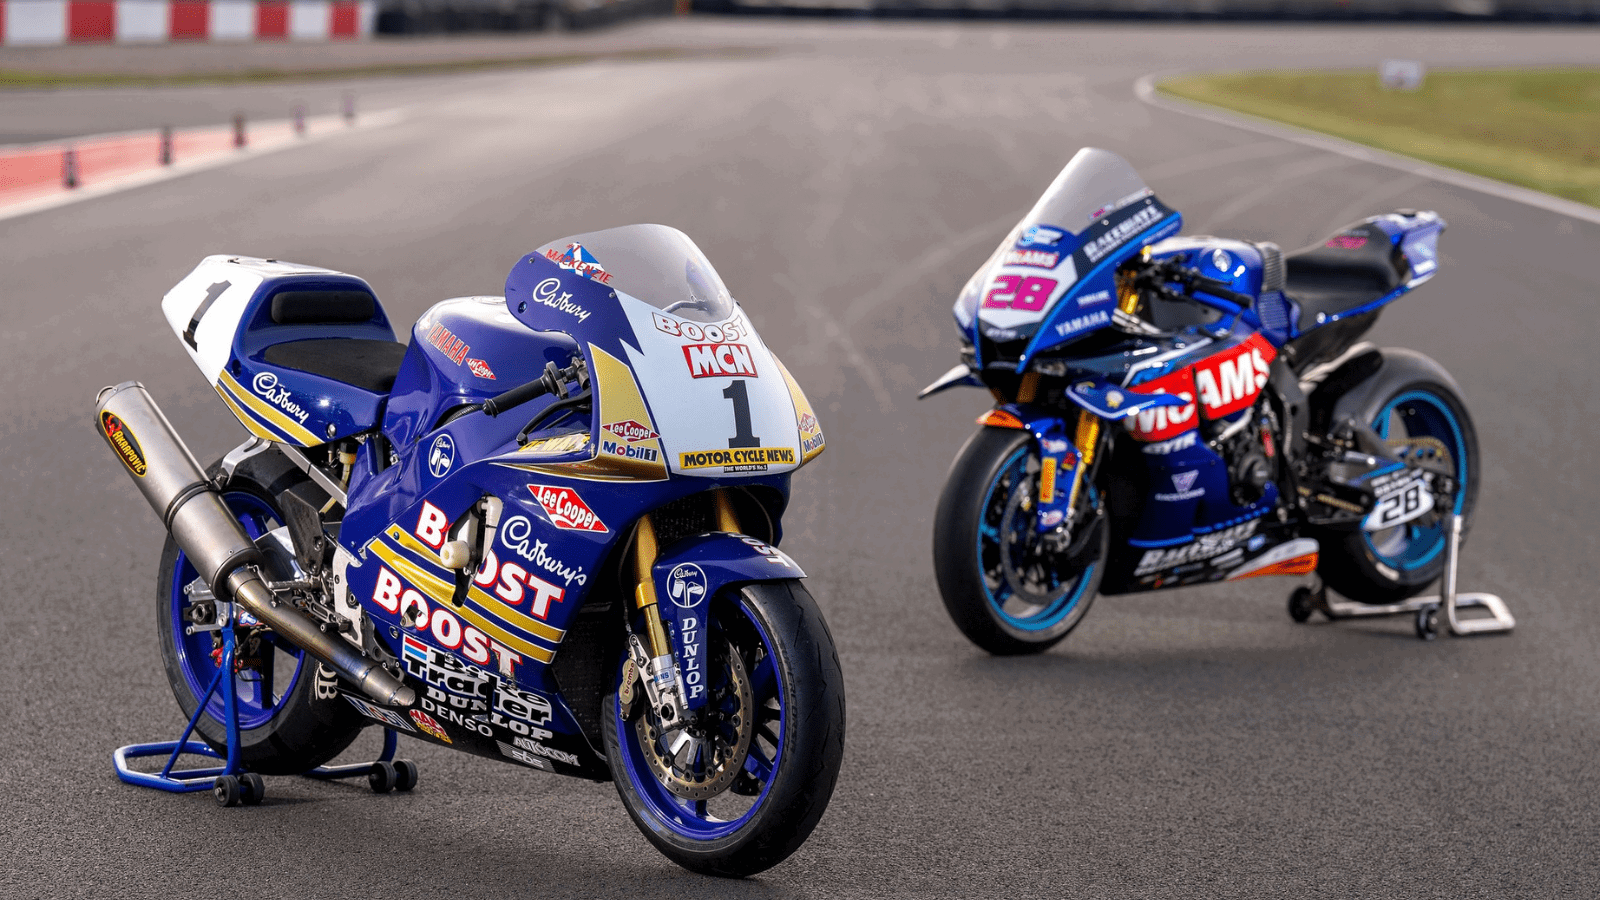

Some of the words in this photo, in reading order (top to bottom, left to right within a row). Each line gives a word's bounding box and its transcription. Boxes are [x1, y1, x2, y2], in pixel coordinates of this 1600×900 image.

[545, 249, 614, 284] MACKENZIE
[533, 278, 591, 324] Cadbury
[980, 275, 1058, 311] 28
[183, 279, 232, 353] 1
[652, 312, 748, 343] BOOST
[1055, 310, 1110, 337] YAMAHA
[426, 321, 470, 367] YAMAHA
[686, 344, 756, 377] MCN
[253, 372, 310, 424] Cadbury
[722, 380, 760, 448] 1
[684, 451, 732, 466] MOTOR
[733, 450, 765, 463] CYCLE
[766, 449, 794, 462] NEWS
[1382, 485, 1419, 524] 28
[501, 515, 587, 586] Cadbury's
[372, 565, 523, 680] BOOST
[624, 662, 635, 695] brembo
[682, 617, 704, 699] DUNLOP
[421, 697, 493, 738] DENSO
[426, 685, 554, 742] DUNLOP
[513, 736, 581, 767] AUTOCOM
